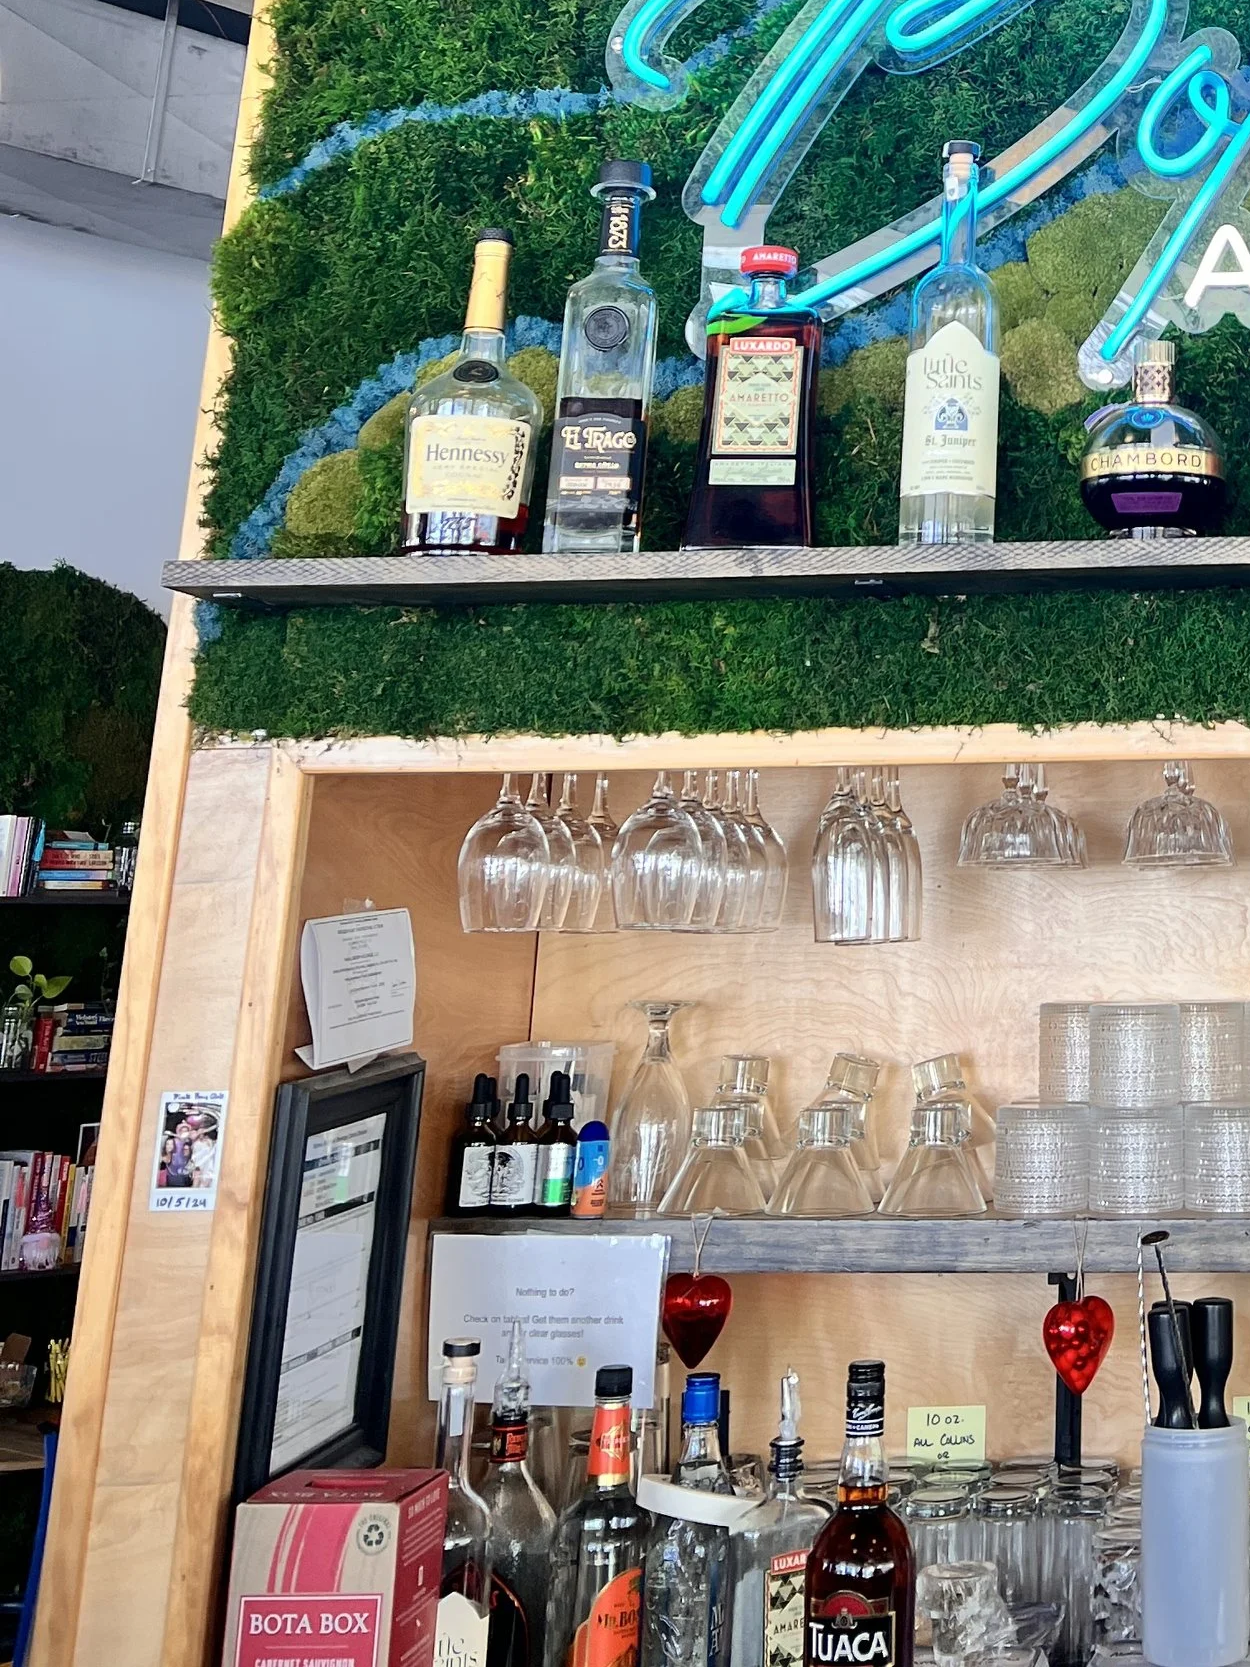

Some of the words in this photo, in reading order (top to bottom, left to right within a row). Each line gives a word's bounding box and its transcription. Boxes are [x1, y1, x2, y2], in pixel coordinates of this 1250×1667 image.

[733, 339, 791, 352] LUXARDO
[729, 392, 789, 403] AMARETTO
[561, 426, 582, 451] EL
[582, 426, 637, 454] TRAGO
[940, 434, 977, 448] Juniper
[426, 443, 510, 468] Hennessy
[1090, 452, 1202, 472] CHAMBORD
[156, 1196, 207, 1209] 10/5/24
[516, 1287, 547, 1298] Nothing
[549, 1288, 557, 1297] to
[559, 1287, 575, 1297] do?
[463, 1314, 488, 1324] Check
[491, 1316, 501, 1324] on
[532, 1315, 548, 1325] Get
[549, 1315, 569, 1325] them
[571, 1315, 602, 1325] another
[604, 1315, 624, 1325] drink
[529, 1328, 548, 1337] clear
[550, 1329, 584, 1339] glasses!
[551, 1356, 573, 1366] 100%
[926, 1413, 941, 1426] 10
[913, 1437, 934, 1448] ALL
[940, 1433, 975, 1446] COLLINS
[773, 1552, 807, 1572] LUXAR
[249, 1613, 313, 1635] BOTA
[319, 1612, 370, 1634] BOX
[773, 1617, 805, 1635] AMARE
[808, 1621, 889, 1662] TUACA
